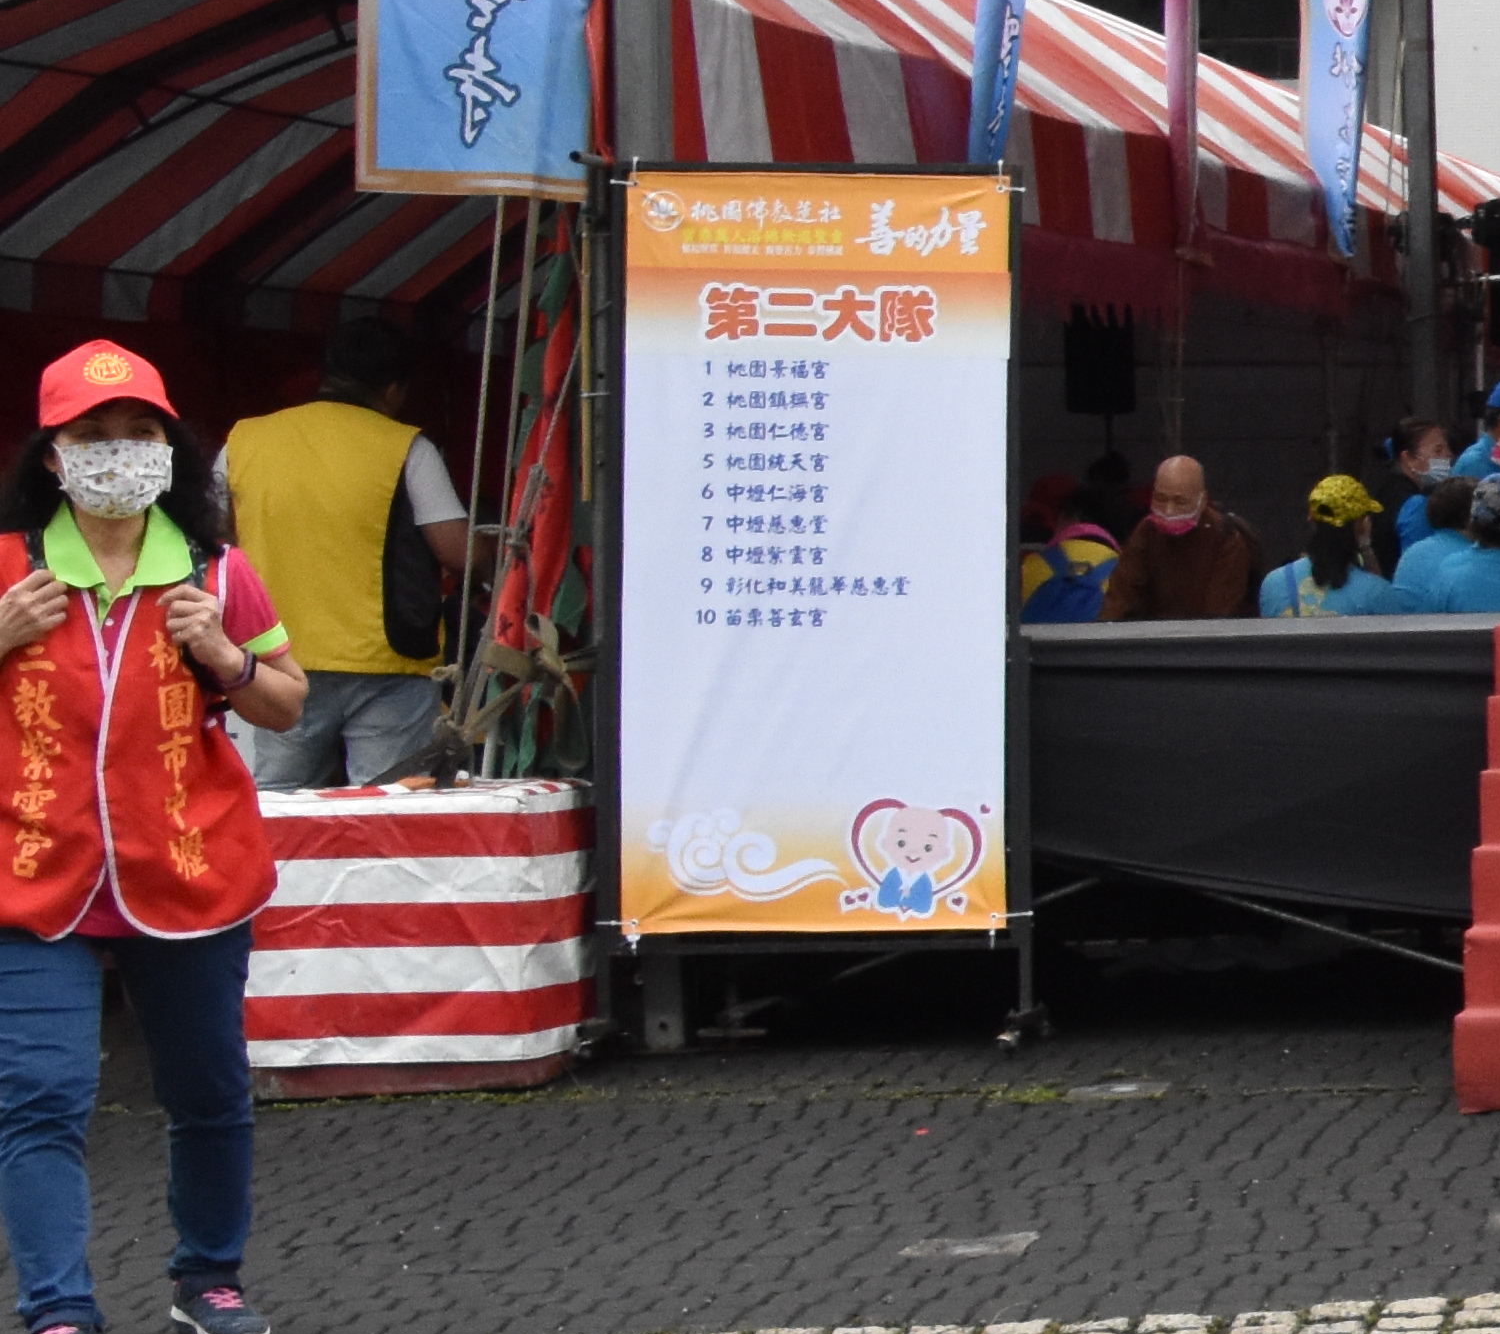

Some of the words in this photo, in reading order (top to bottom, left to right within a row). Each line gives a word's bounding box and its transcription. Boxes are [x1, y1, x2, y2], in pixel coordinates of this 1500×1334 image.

[855, 200, 987, 257] 善的力量
[703, 285, 937, 345] 第二大隊
[705, 360, 712, 376] 1
[726, 359, 830, 380] 桃園景福宮
[702, 391, 714, 407] 2
[703, 422, 714, 439] 3
[702, 453, 714, 469] 5
[701, 483, 714, 500] 6
[702, 516, 713, 531] 7
[701, 545, 713, 562] 8
[700, 577, 713, 594] 9
[696, 609, 717, 625] 10
